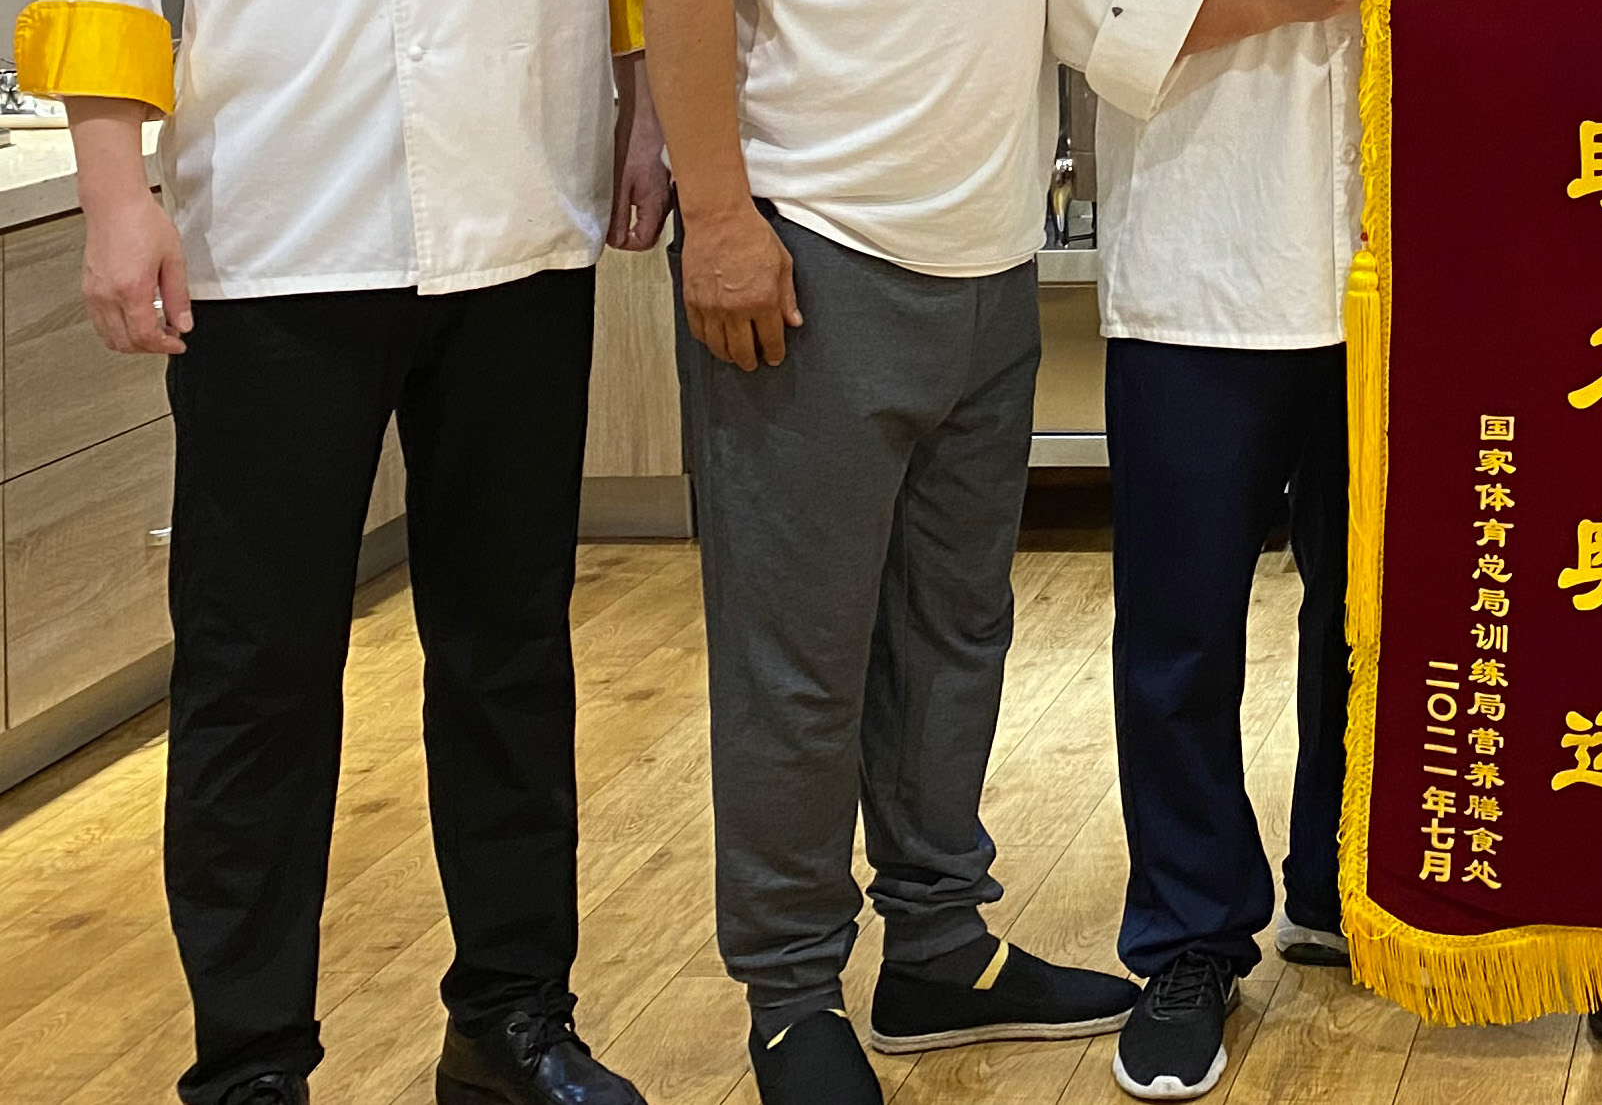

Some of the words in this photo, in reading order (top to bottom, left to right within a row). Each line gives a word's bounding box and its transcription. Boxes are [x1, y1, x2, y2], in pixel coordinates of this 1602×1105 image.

[1461, 415, 1517, 890] 国家体育总局训练局营养膳食处
